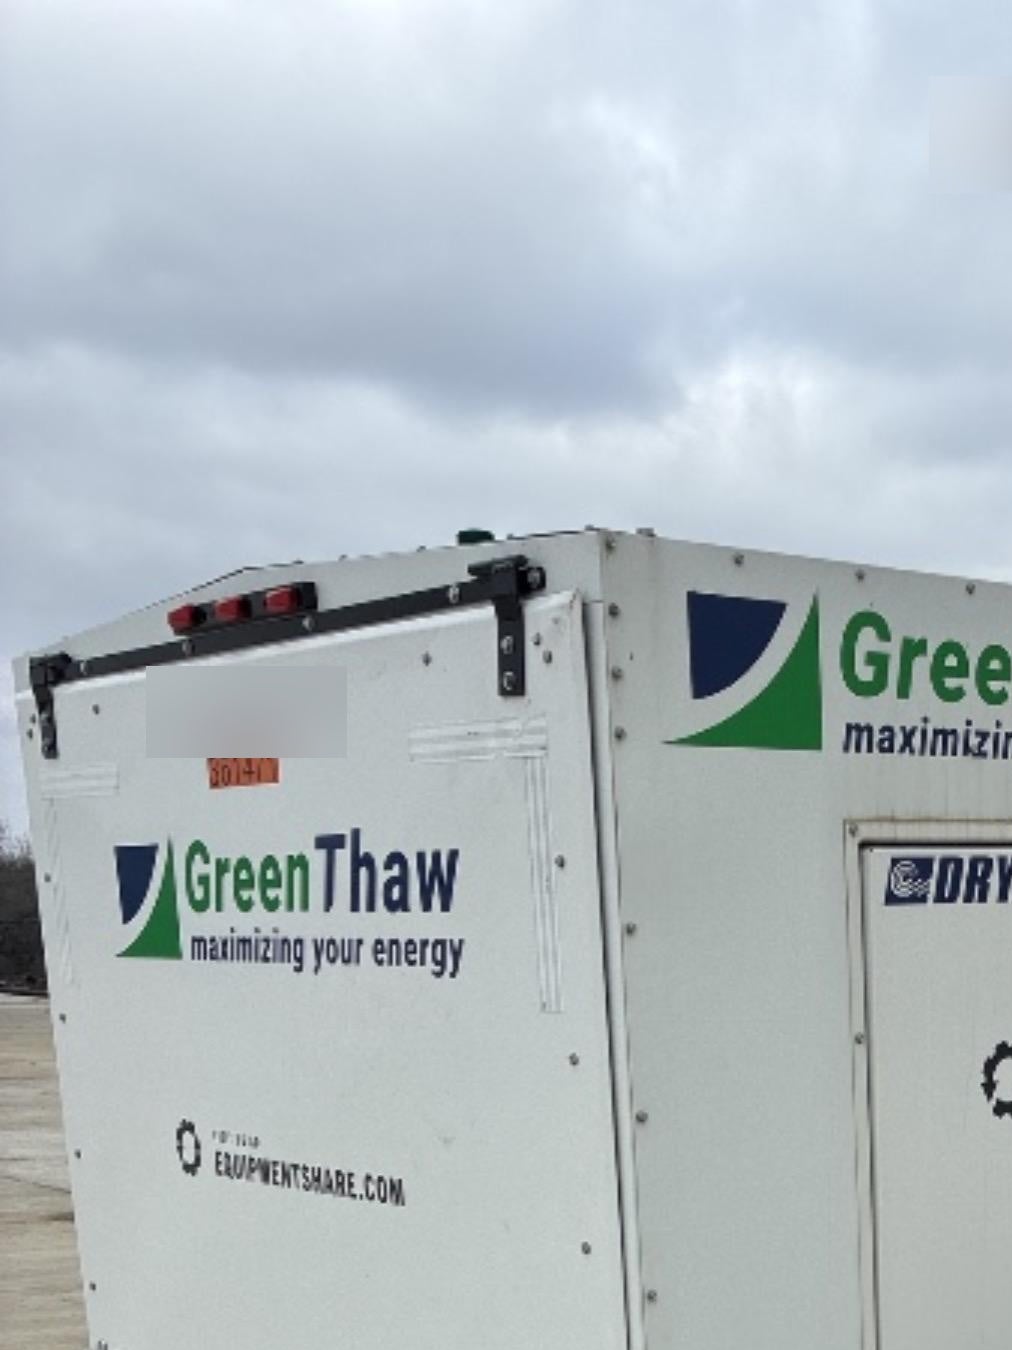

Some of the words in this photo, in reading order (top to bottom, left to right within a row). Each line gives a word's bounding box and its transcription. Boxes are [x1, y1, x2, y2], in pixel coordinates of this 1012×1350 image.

[185, 827, 460, 913] GreenThaw
[190, 927, 304, 973] maximizing
[312, 936, 363, 975] your
[372, 937, 465, 978] energy
[214, 1150, 406, 1206] EQUIPMENTSHARE.COM
